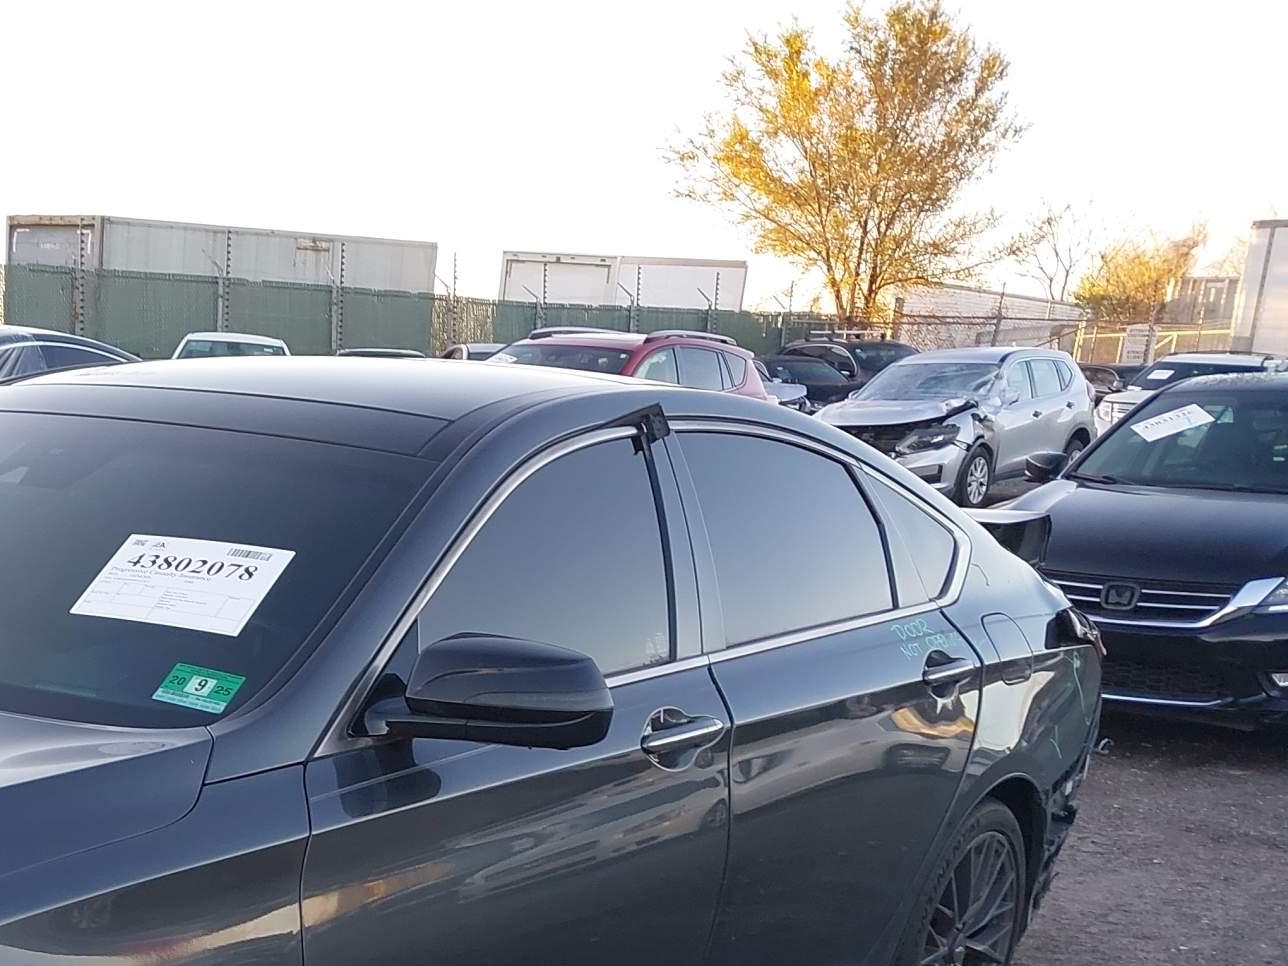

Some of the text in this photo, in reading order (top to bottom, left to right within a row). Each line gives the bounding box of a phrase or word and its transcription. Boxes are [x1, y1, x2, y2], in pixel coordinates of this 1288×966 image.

[127, 553, 259, 581] 43802078
[890, 618, 935, 641] DOOR
[169, 675, 233, 696] 20 9 25
